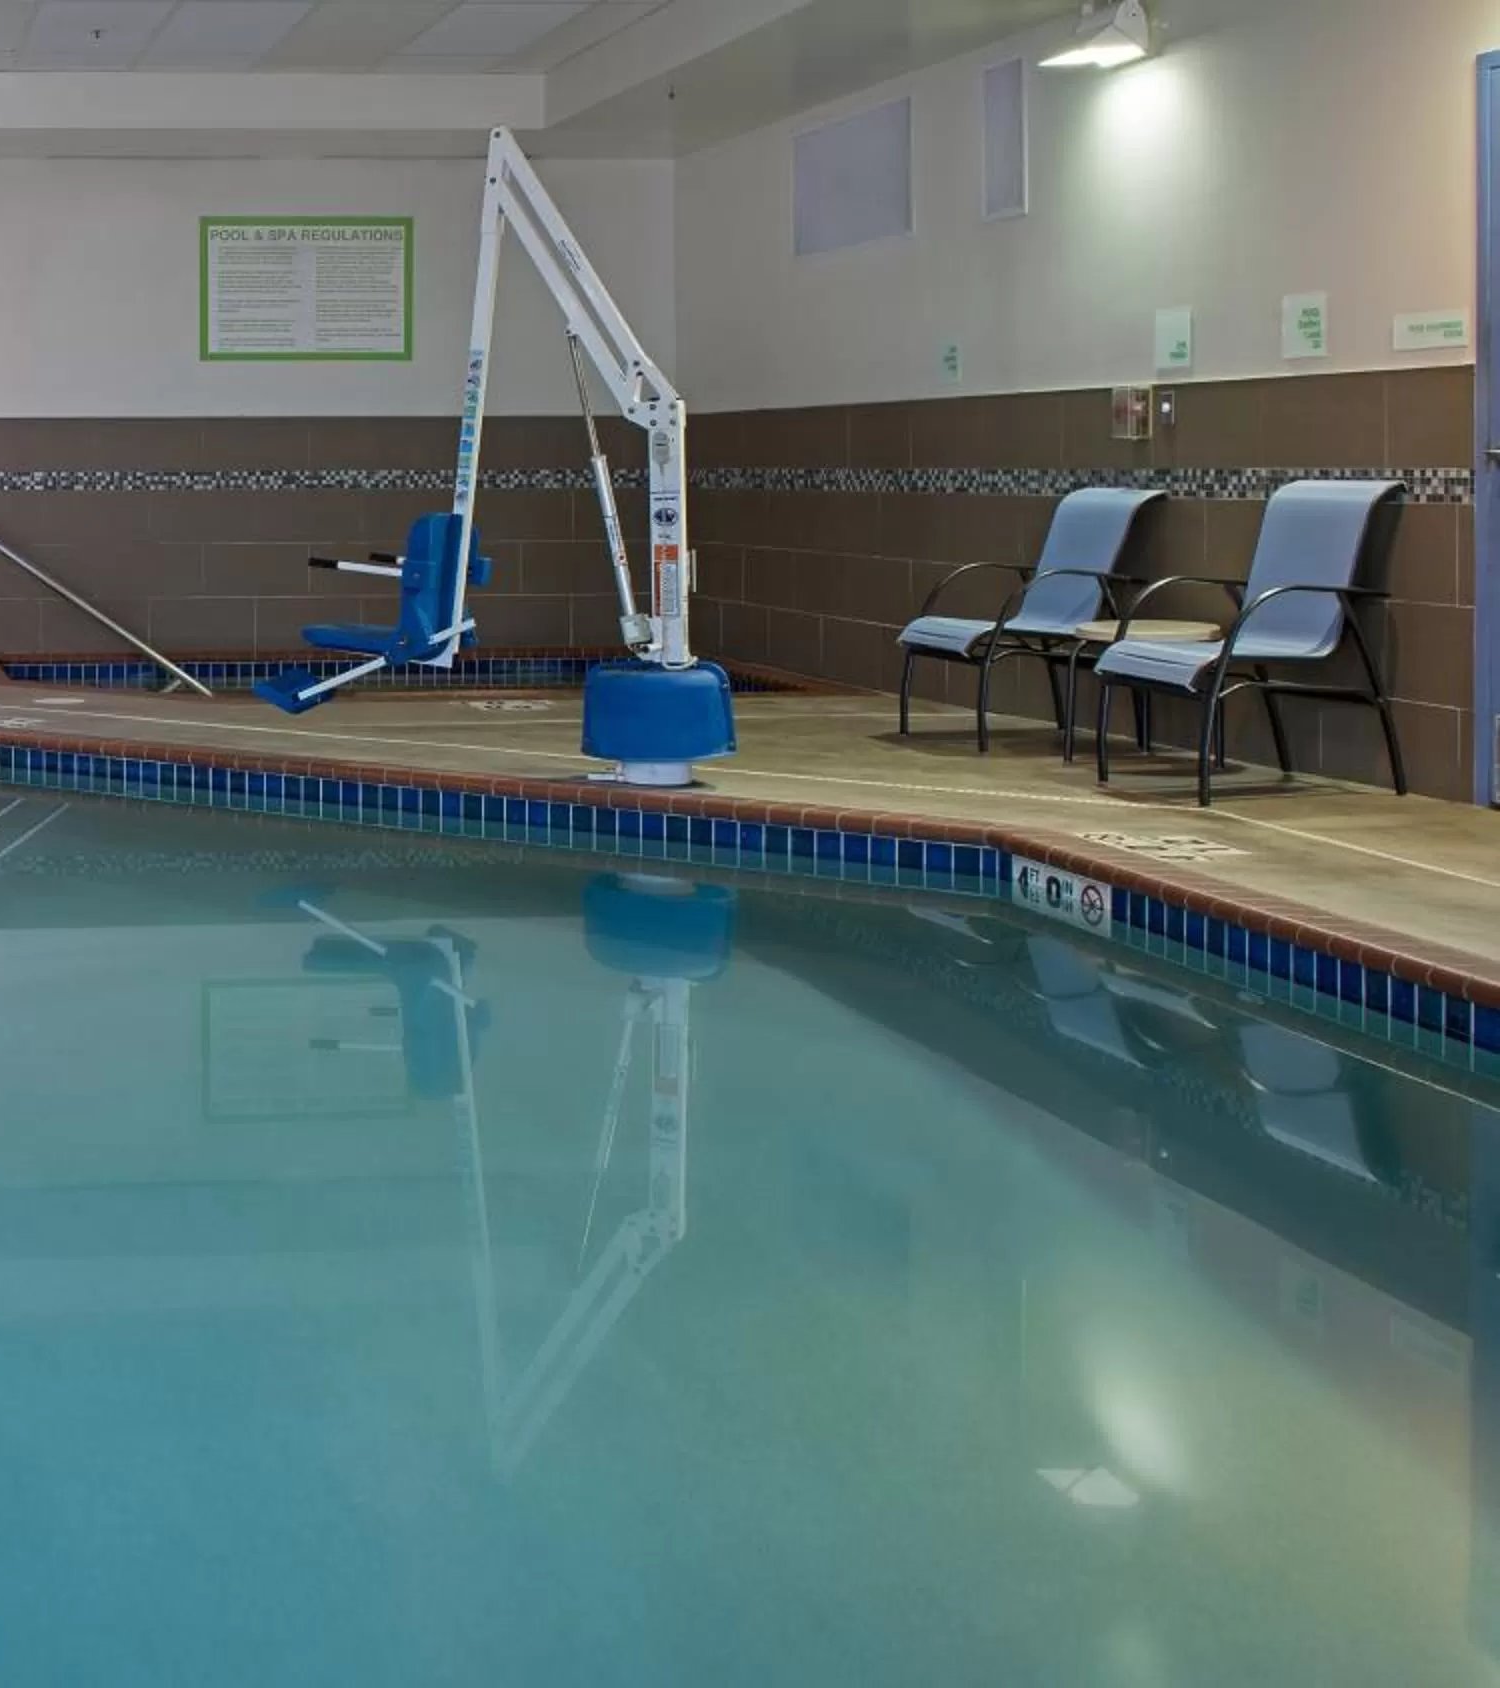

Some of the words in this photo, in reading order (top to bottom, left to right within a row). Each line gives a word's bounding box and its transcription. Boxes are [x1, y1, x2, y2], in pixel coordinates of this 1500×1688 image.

[210, 229, 249, 241] POOL
[254, 229, 264, 241] &
[268, 229, 297, 241] SPA
[301, 228, 404, 241] REGULATIONS
[1030, 868, 1040, 883] FT
